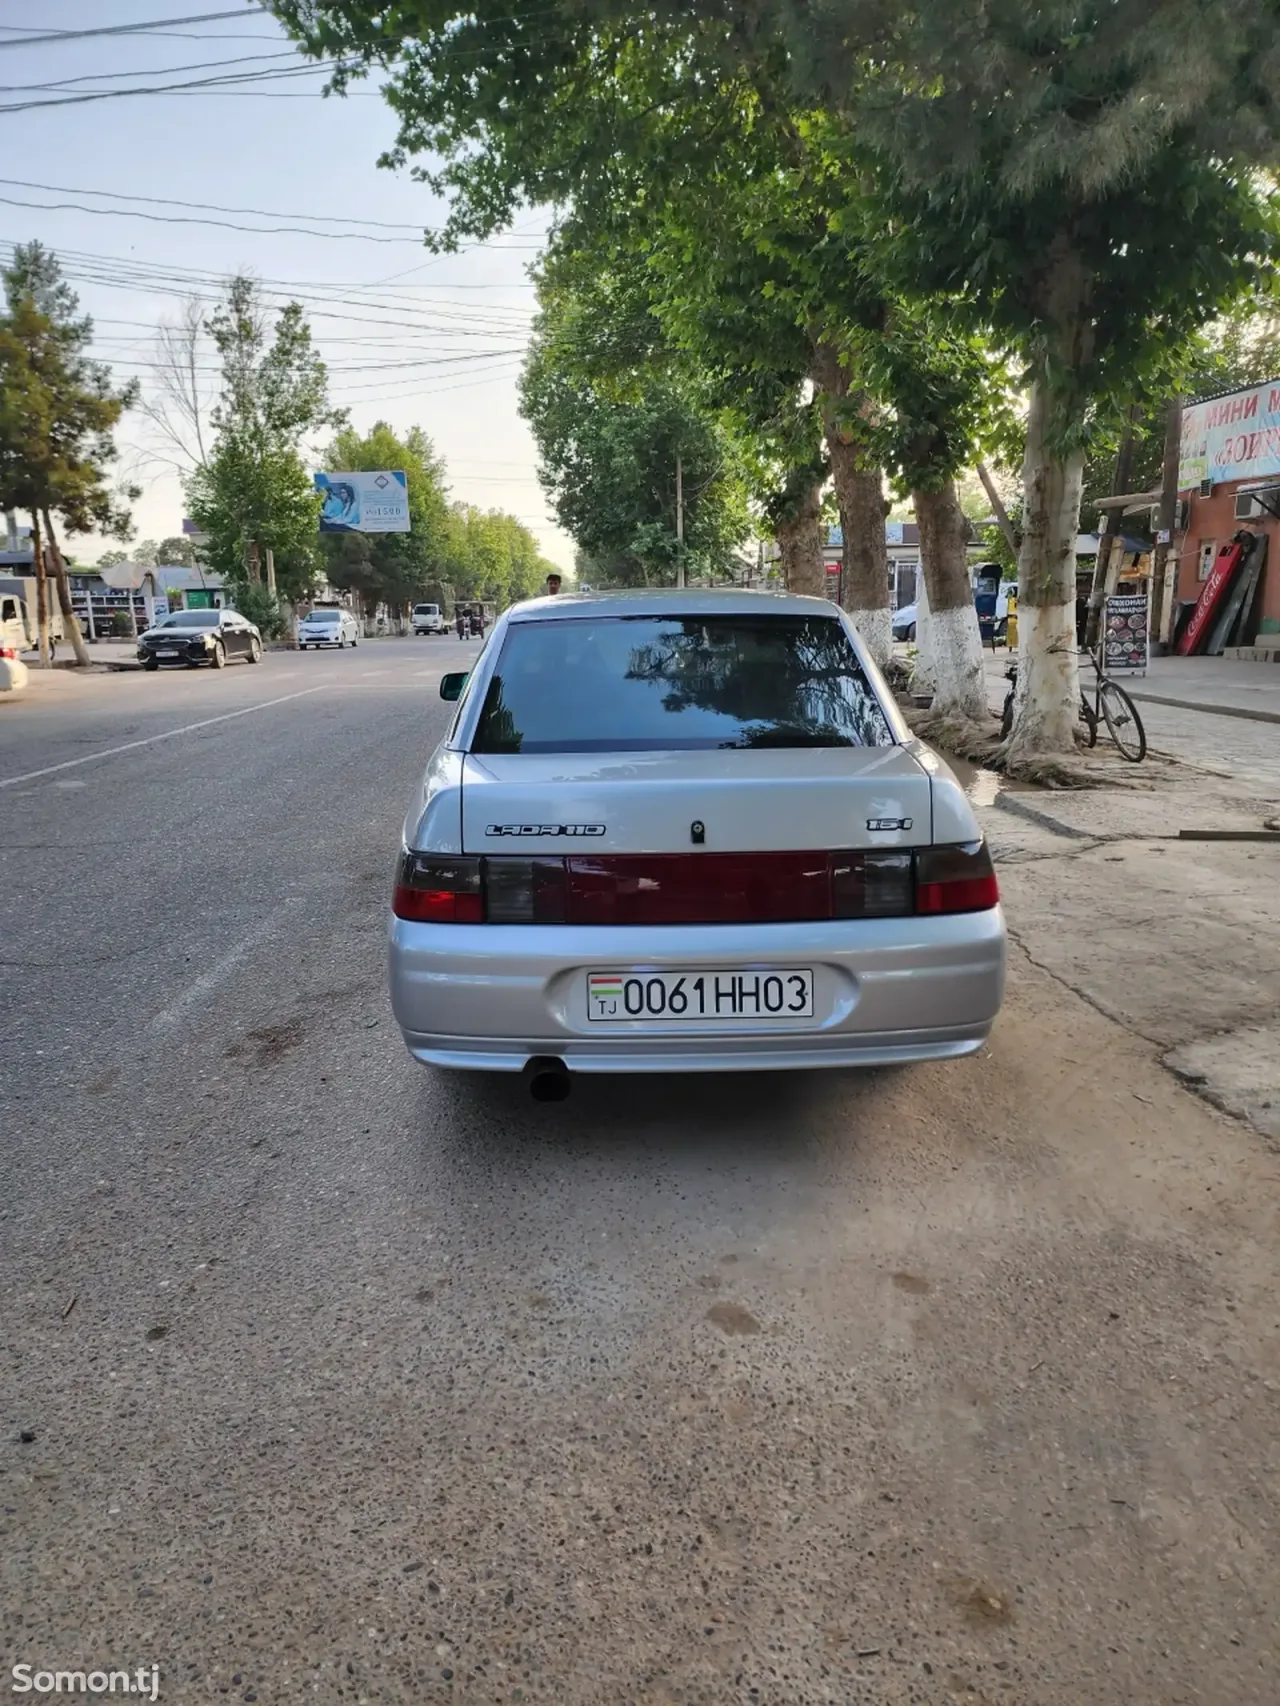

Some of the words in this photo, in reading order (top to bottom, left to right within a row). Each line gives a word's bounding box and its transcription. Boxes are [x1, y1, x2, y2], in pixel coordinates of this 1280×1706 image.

[1204, 394, 1258, 430] МИНИ
[485, 824, 561, 836] LADA
[565, 824, 606, 836] 110
[598, 1000, 617, 1015] TJ
